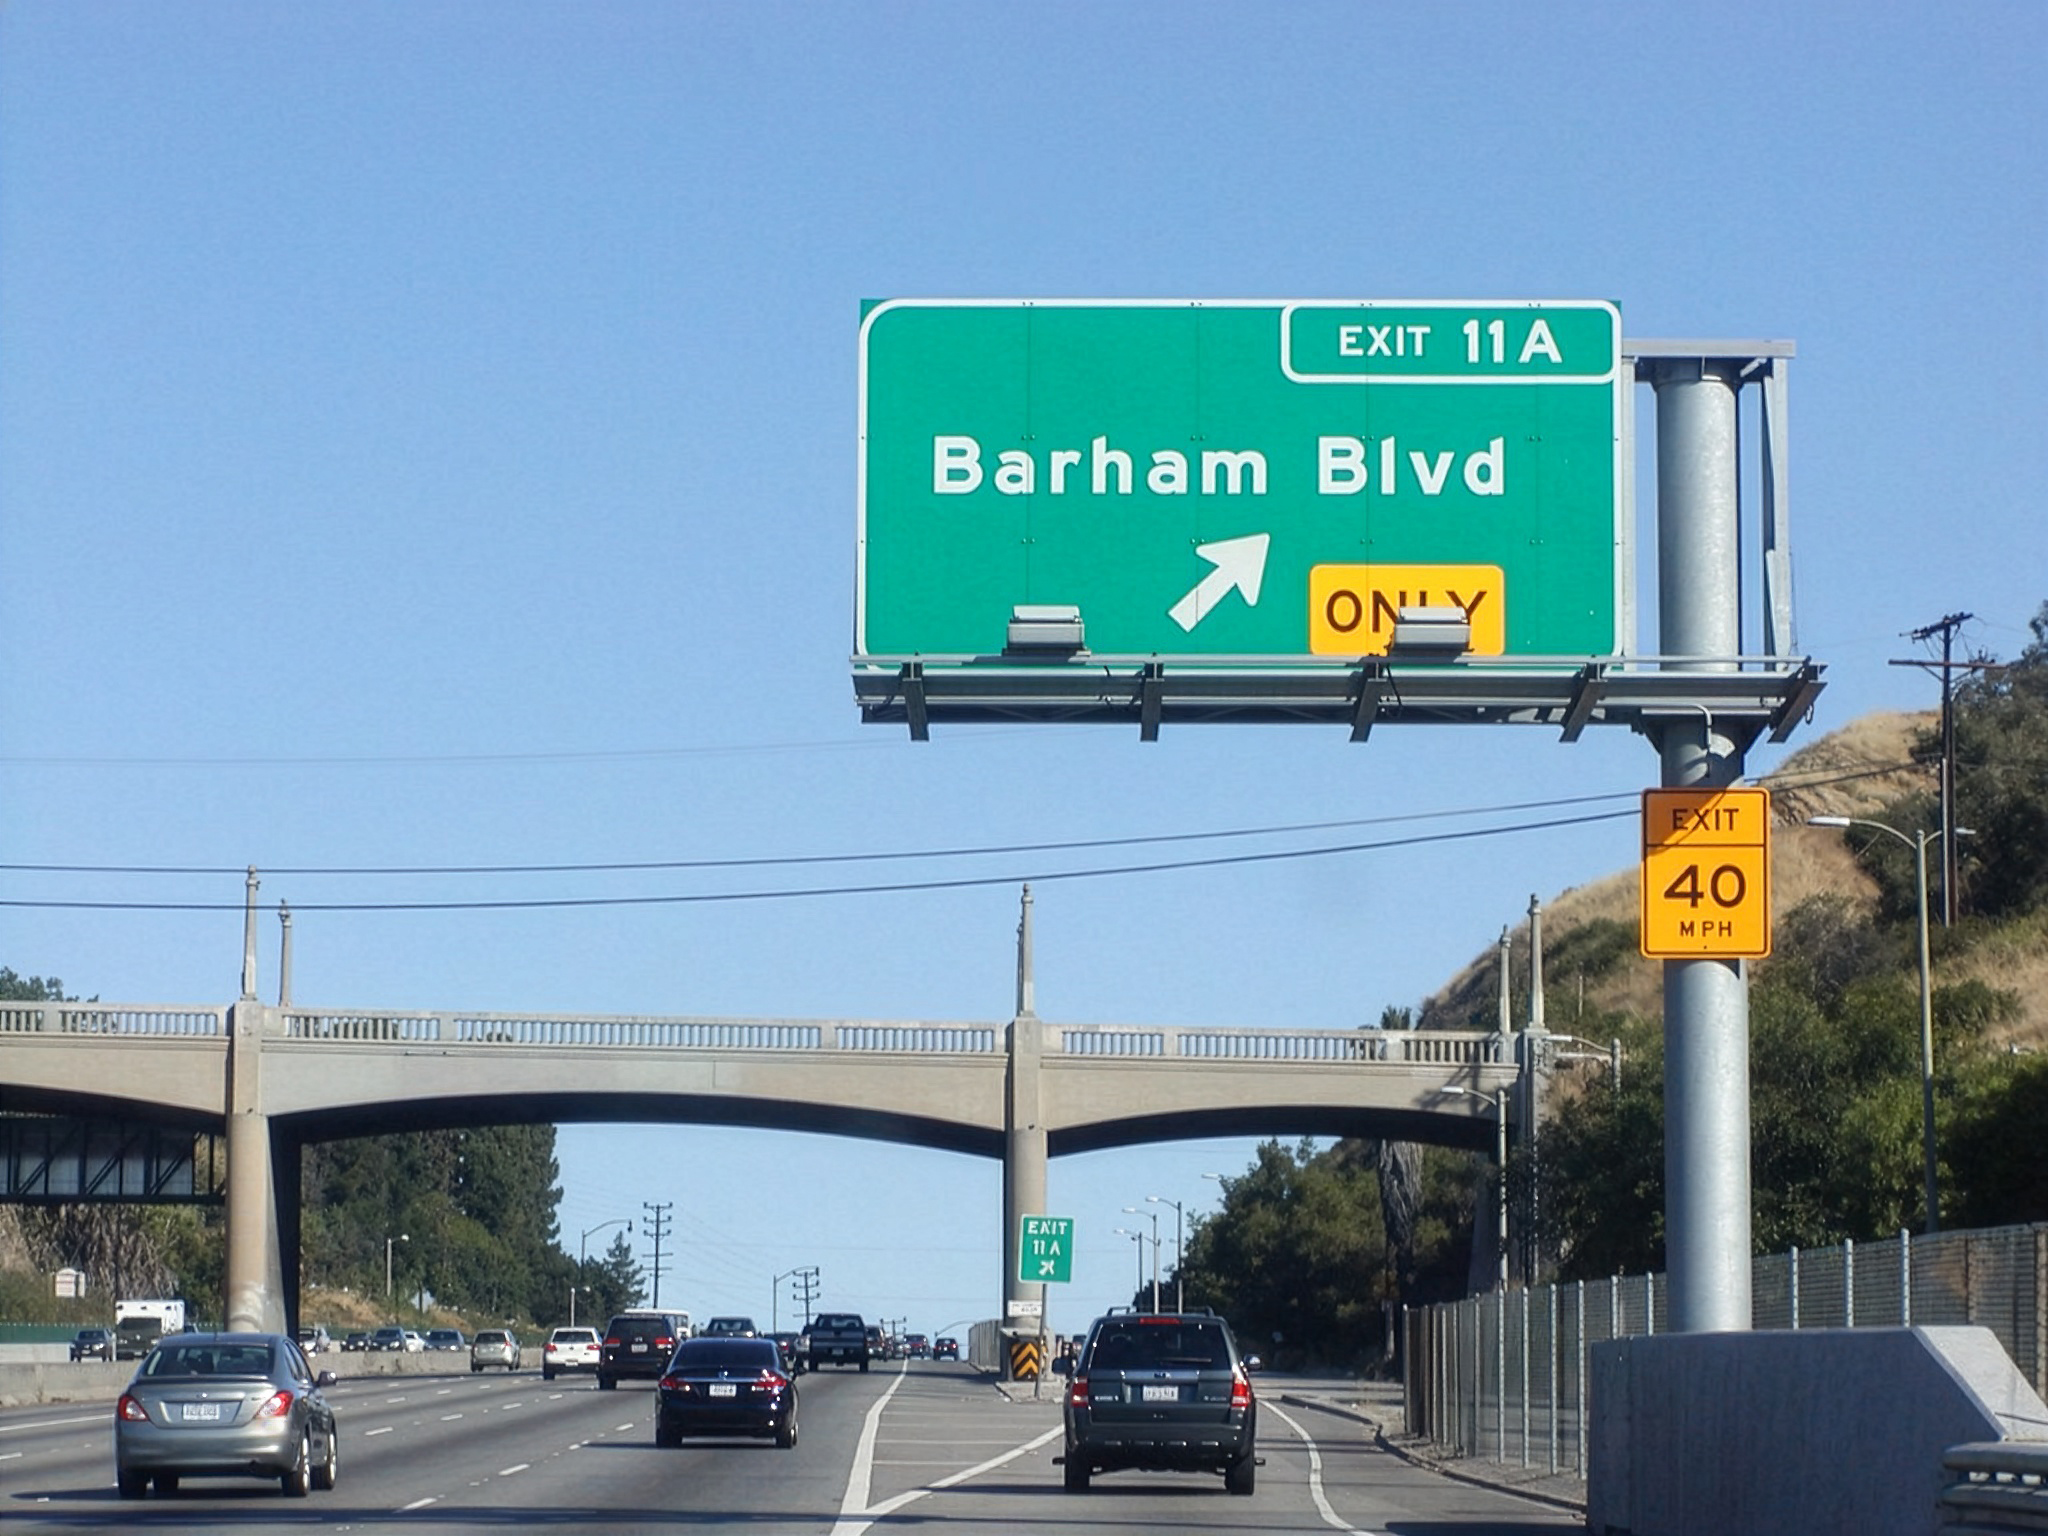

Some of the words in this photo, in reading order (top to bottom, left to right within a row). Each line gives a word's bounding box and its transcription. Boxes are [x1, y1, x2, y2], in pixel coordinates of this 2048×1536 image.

[1339, 325, 1431, 357] EXIT
[1463, 319, 1563, 363] 11A
[932, 435, 1268, 495] Barham
[1317, 435, 1506, 496] Blvd
[1671, 808, 1740, 831] EXIT
[1663, 864, 1746, 908] 40
[1680, 921, 1732, 938] MPH
[1027, 1220, 1068, 1235] EXIT
